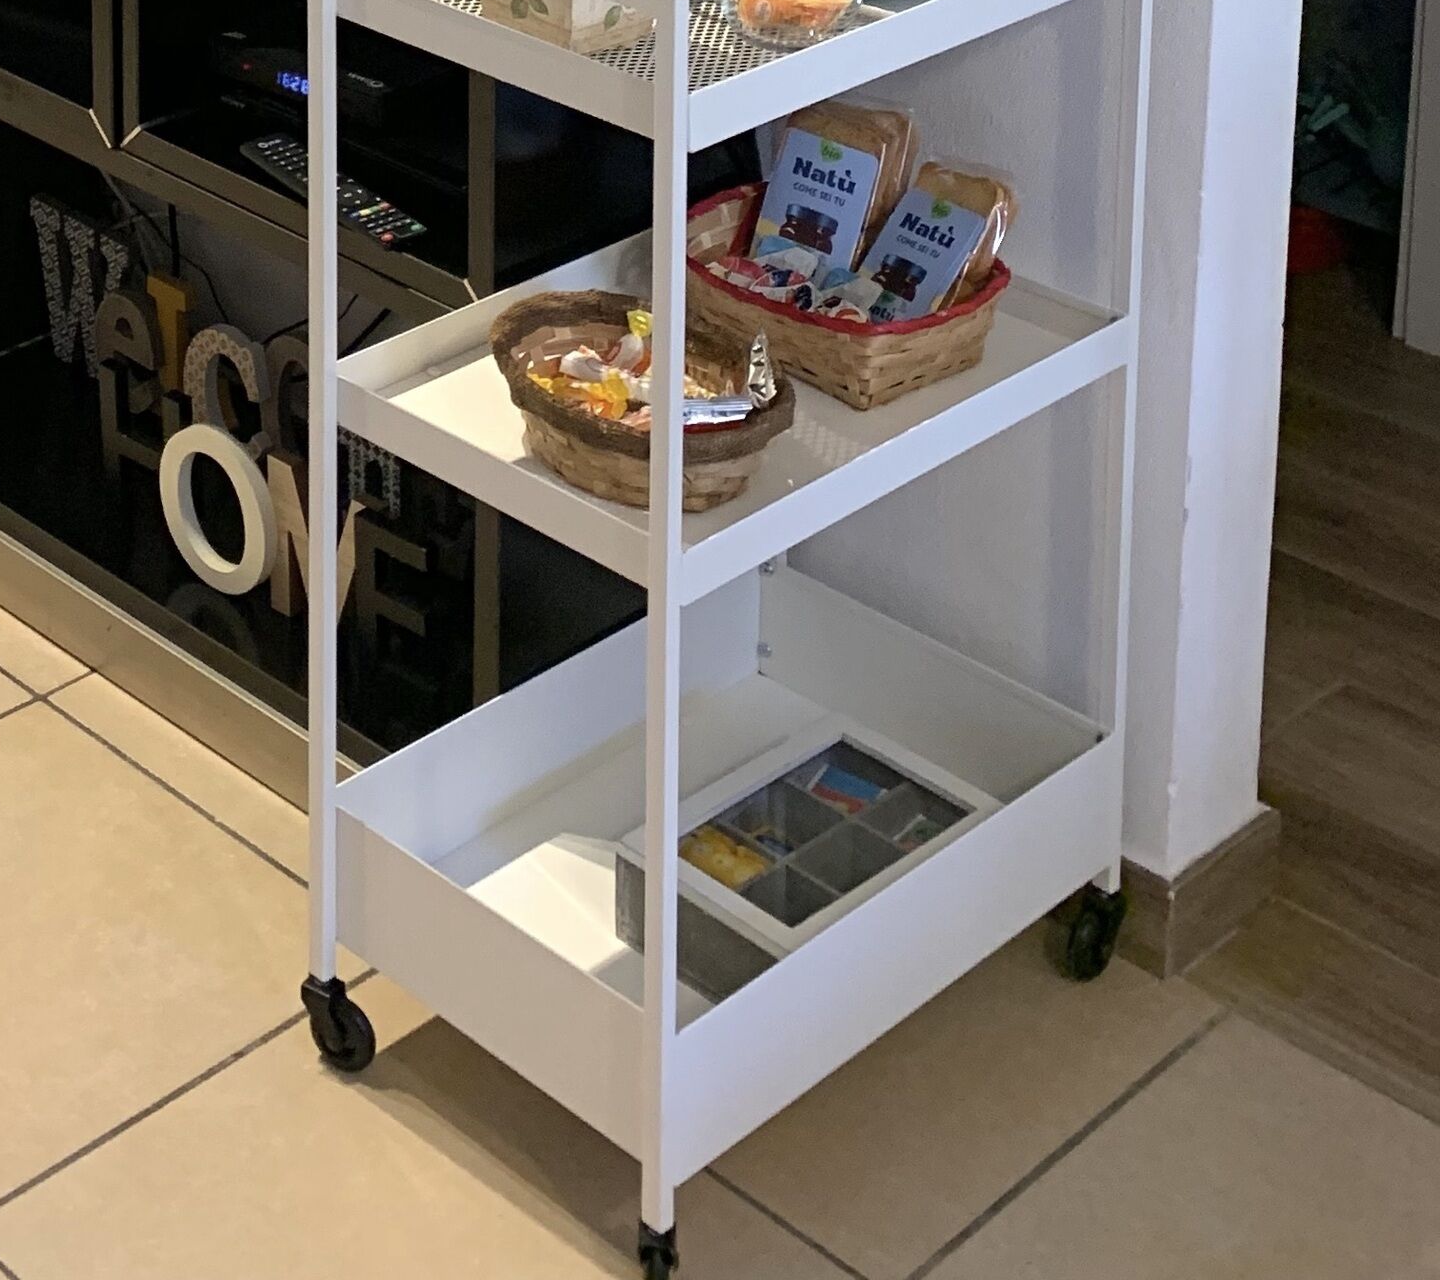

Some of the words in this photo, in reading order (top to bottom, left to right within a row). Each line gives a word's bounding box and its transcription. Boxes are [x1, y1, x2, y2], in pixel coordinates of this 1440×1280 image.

[792, 156, 856, 196] Natù
[793, 182, 818, 197] COME
[833, 196, 846, 207] TU
[899, 212, 955, 249] Natù
